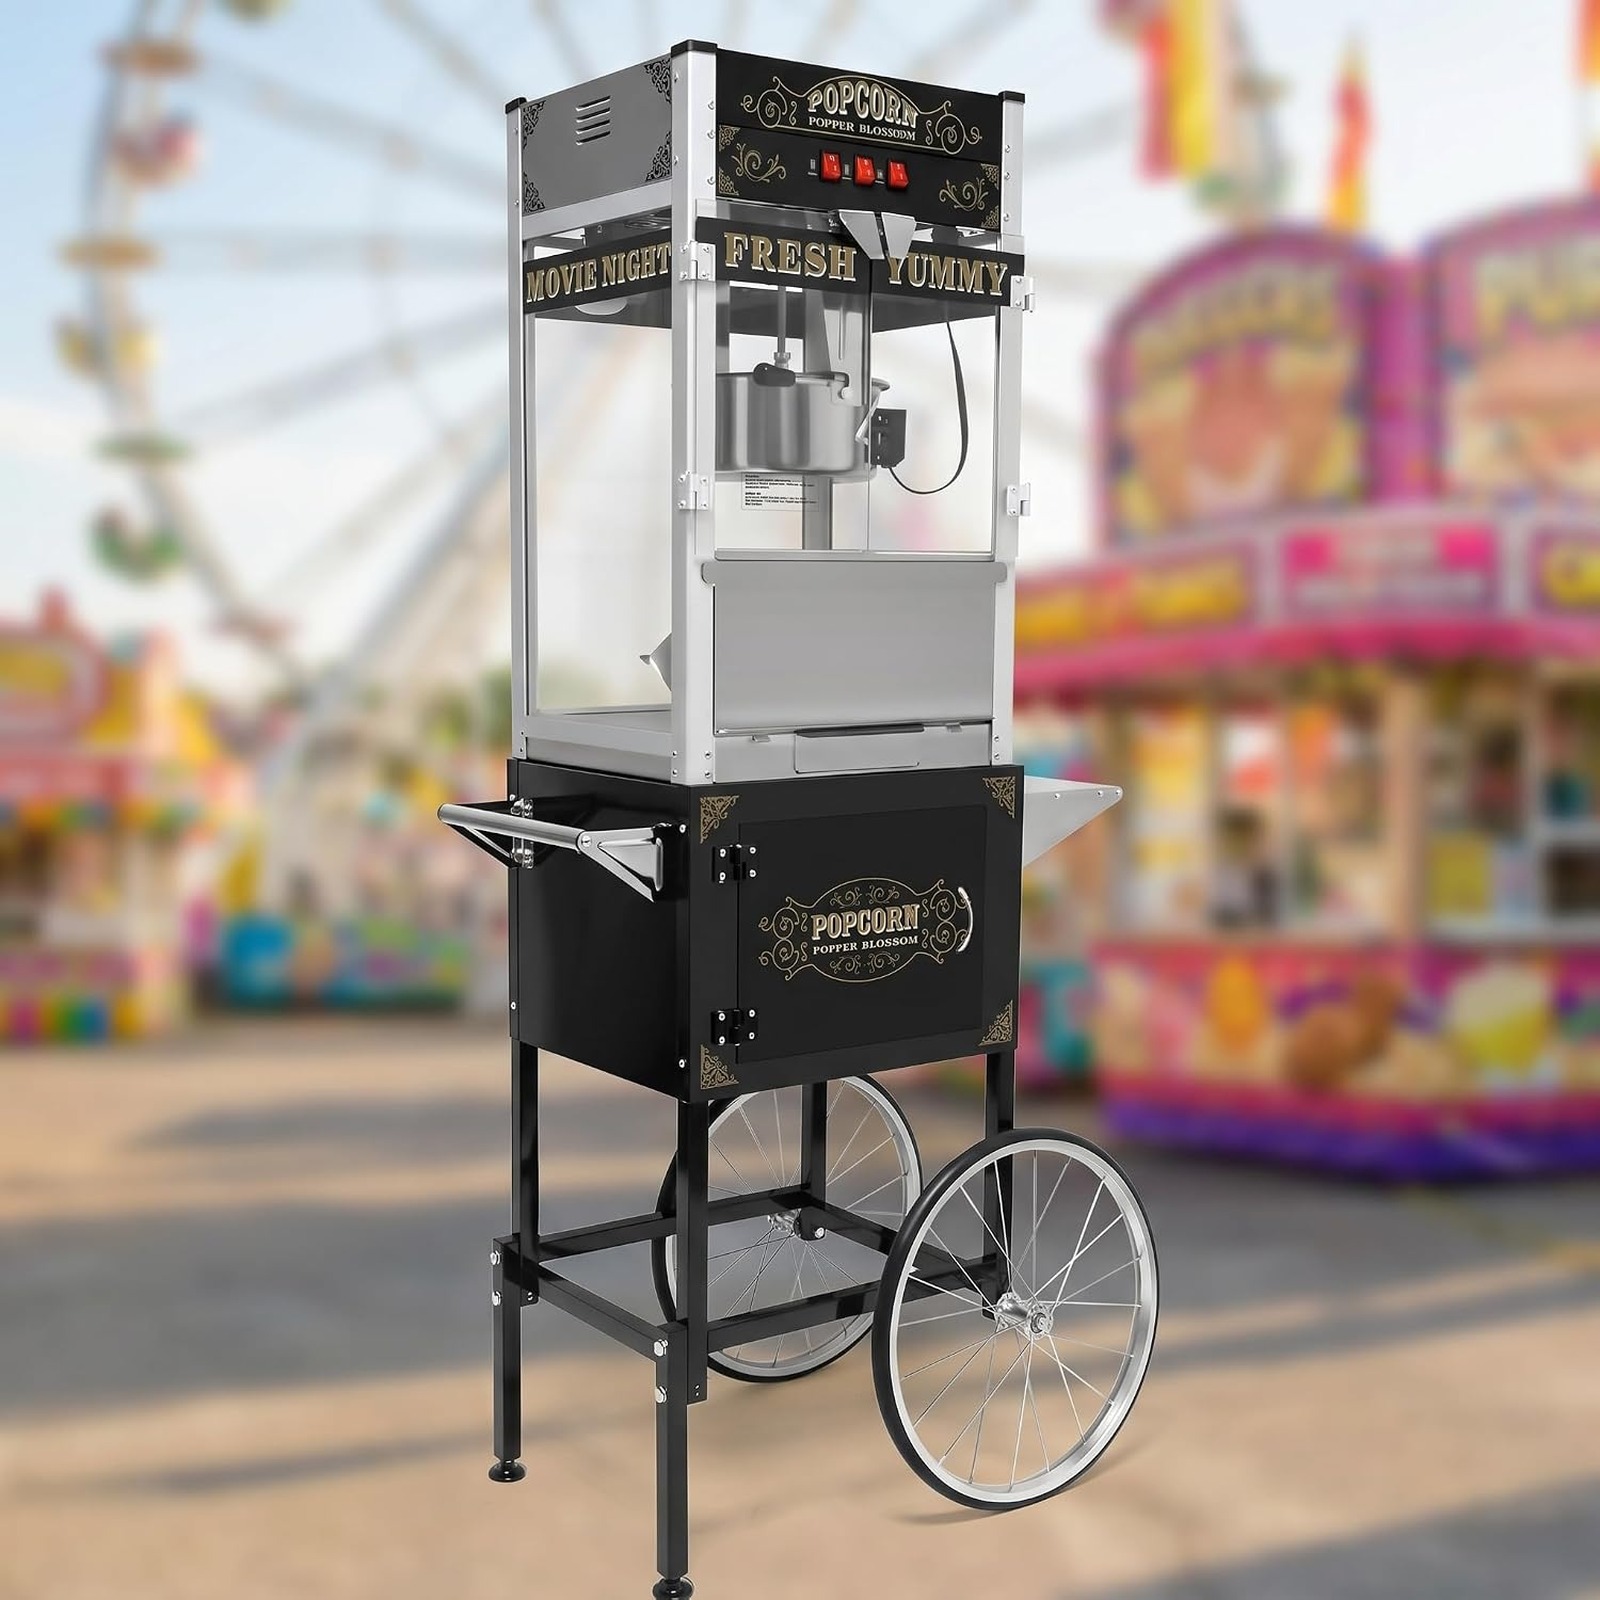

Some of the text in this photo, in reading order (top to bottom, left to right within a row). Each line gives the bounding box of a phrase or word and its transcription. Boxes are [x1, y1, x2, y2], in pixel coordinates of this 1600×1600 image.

[807, 80, 919, 128] POPCORN
[808, 116, 855, 132] POPPER
[526, 241, 672, 303] MOVIE NIGHT
[724, 232, 857, 282] FRESH
[887, 252, 1008, 296] YUMMY
[811, 904, 920, 940] POPCORN
[813, 935, 919, 955] POPPER BLOSSOM
